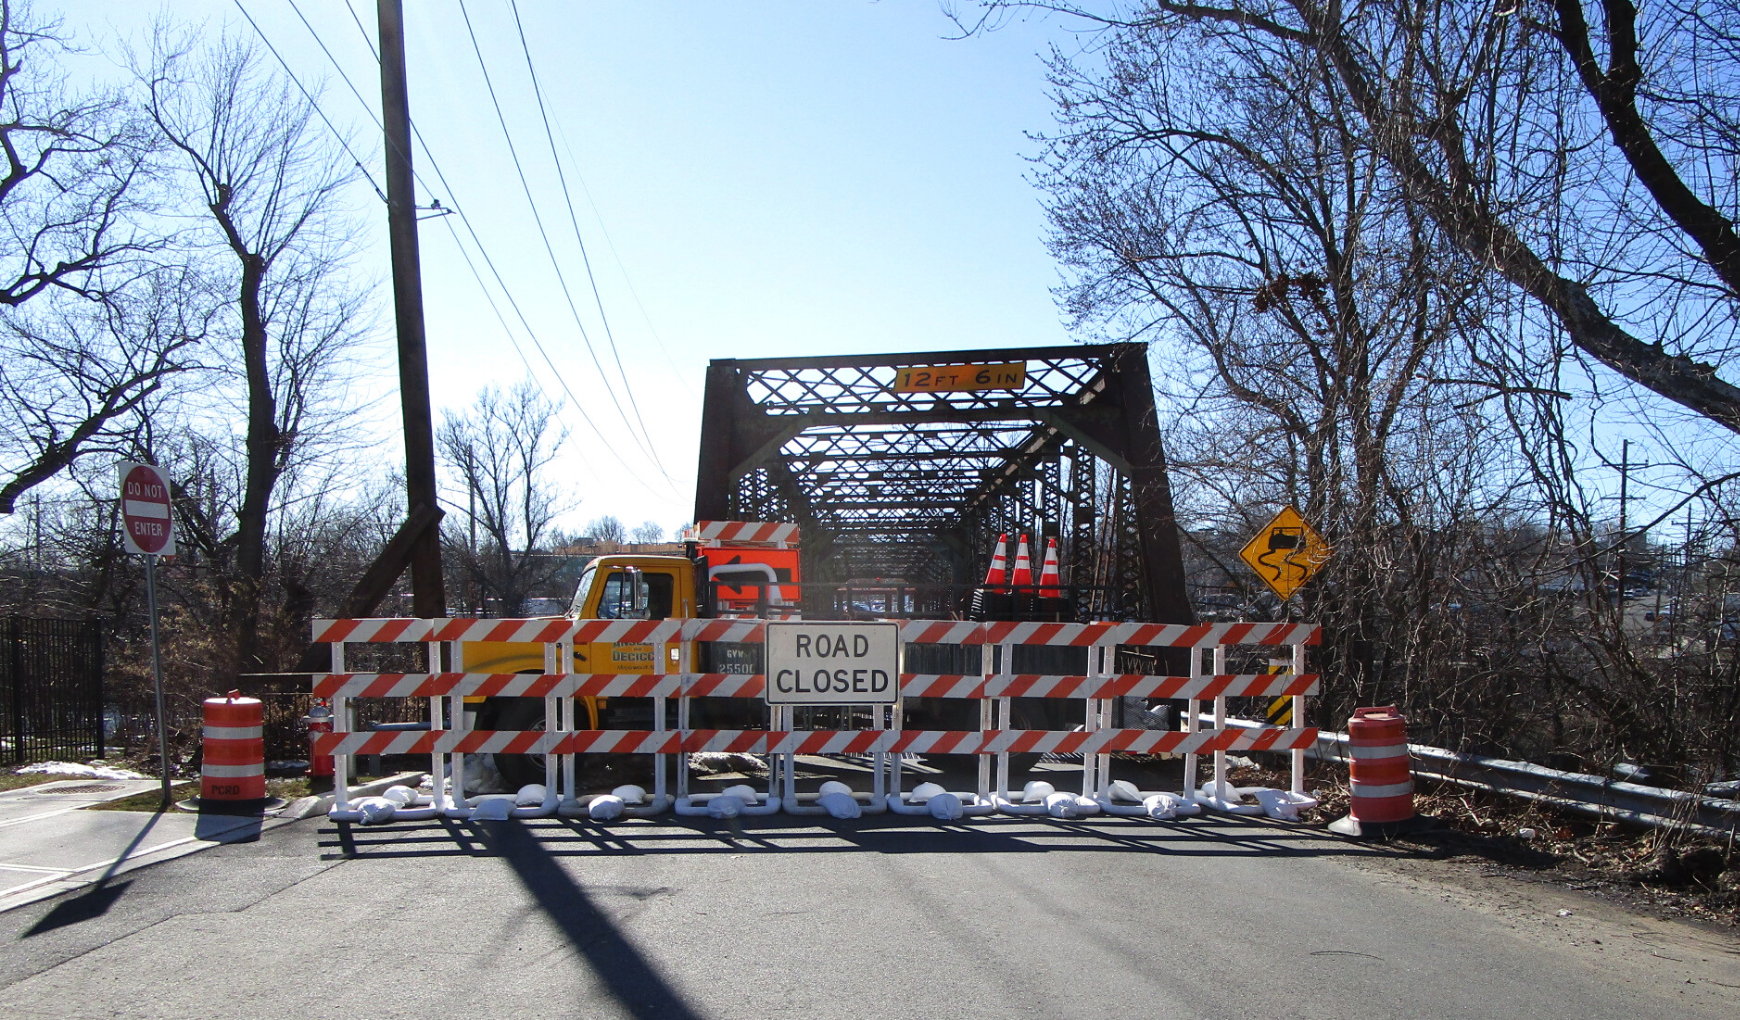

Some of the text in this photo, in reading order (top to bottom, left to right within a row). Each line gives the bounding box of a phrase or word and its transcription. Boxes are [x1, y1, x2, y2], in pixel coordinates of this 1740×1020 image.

[128, 481, 162, 498] DO NOT
[134, 521, 163, 537] ENTER
[796, 633, 869, 658] ROAD
[612, 650, 655, 662] DECICC
[776, 669, 889, 693] CLOSED
